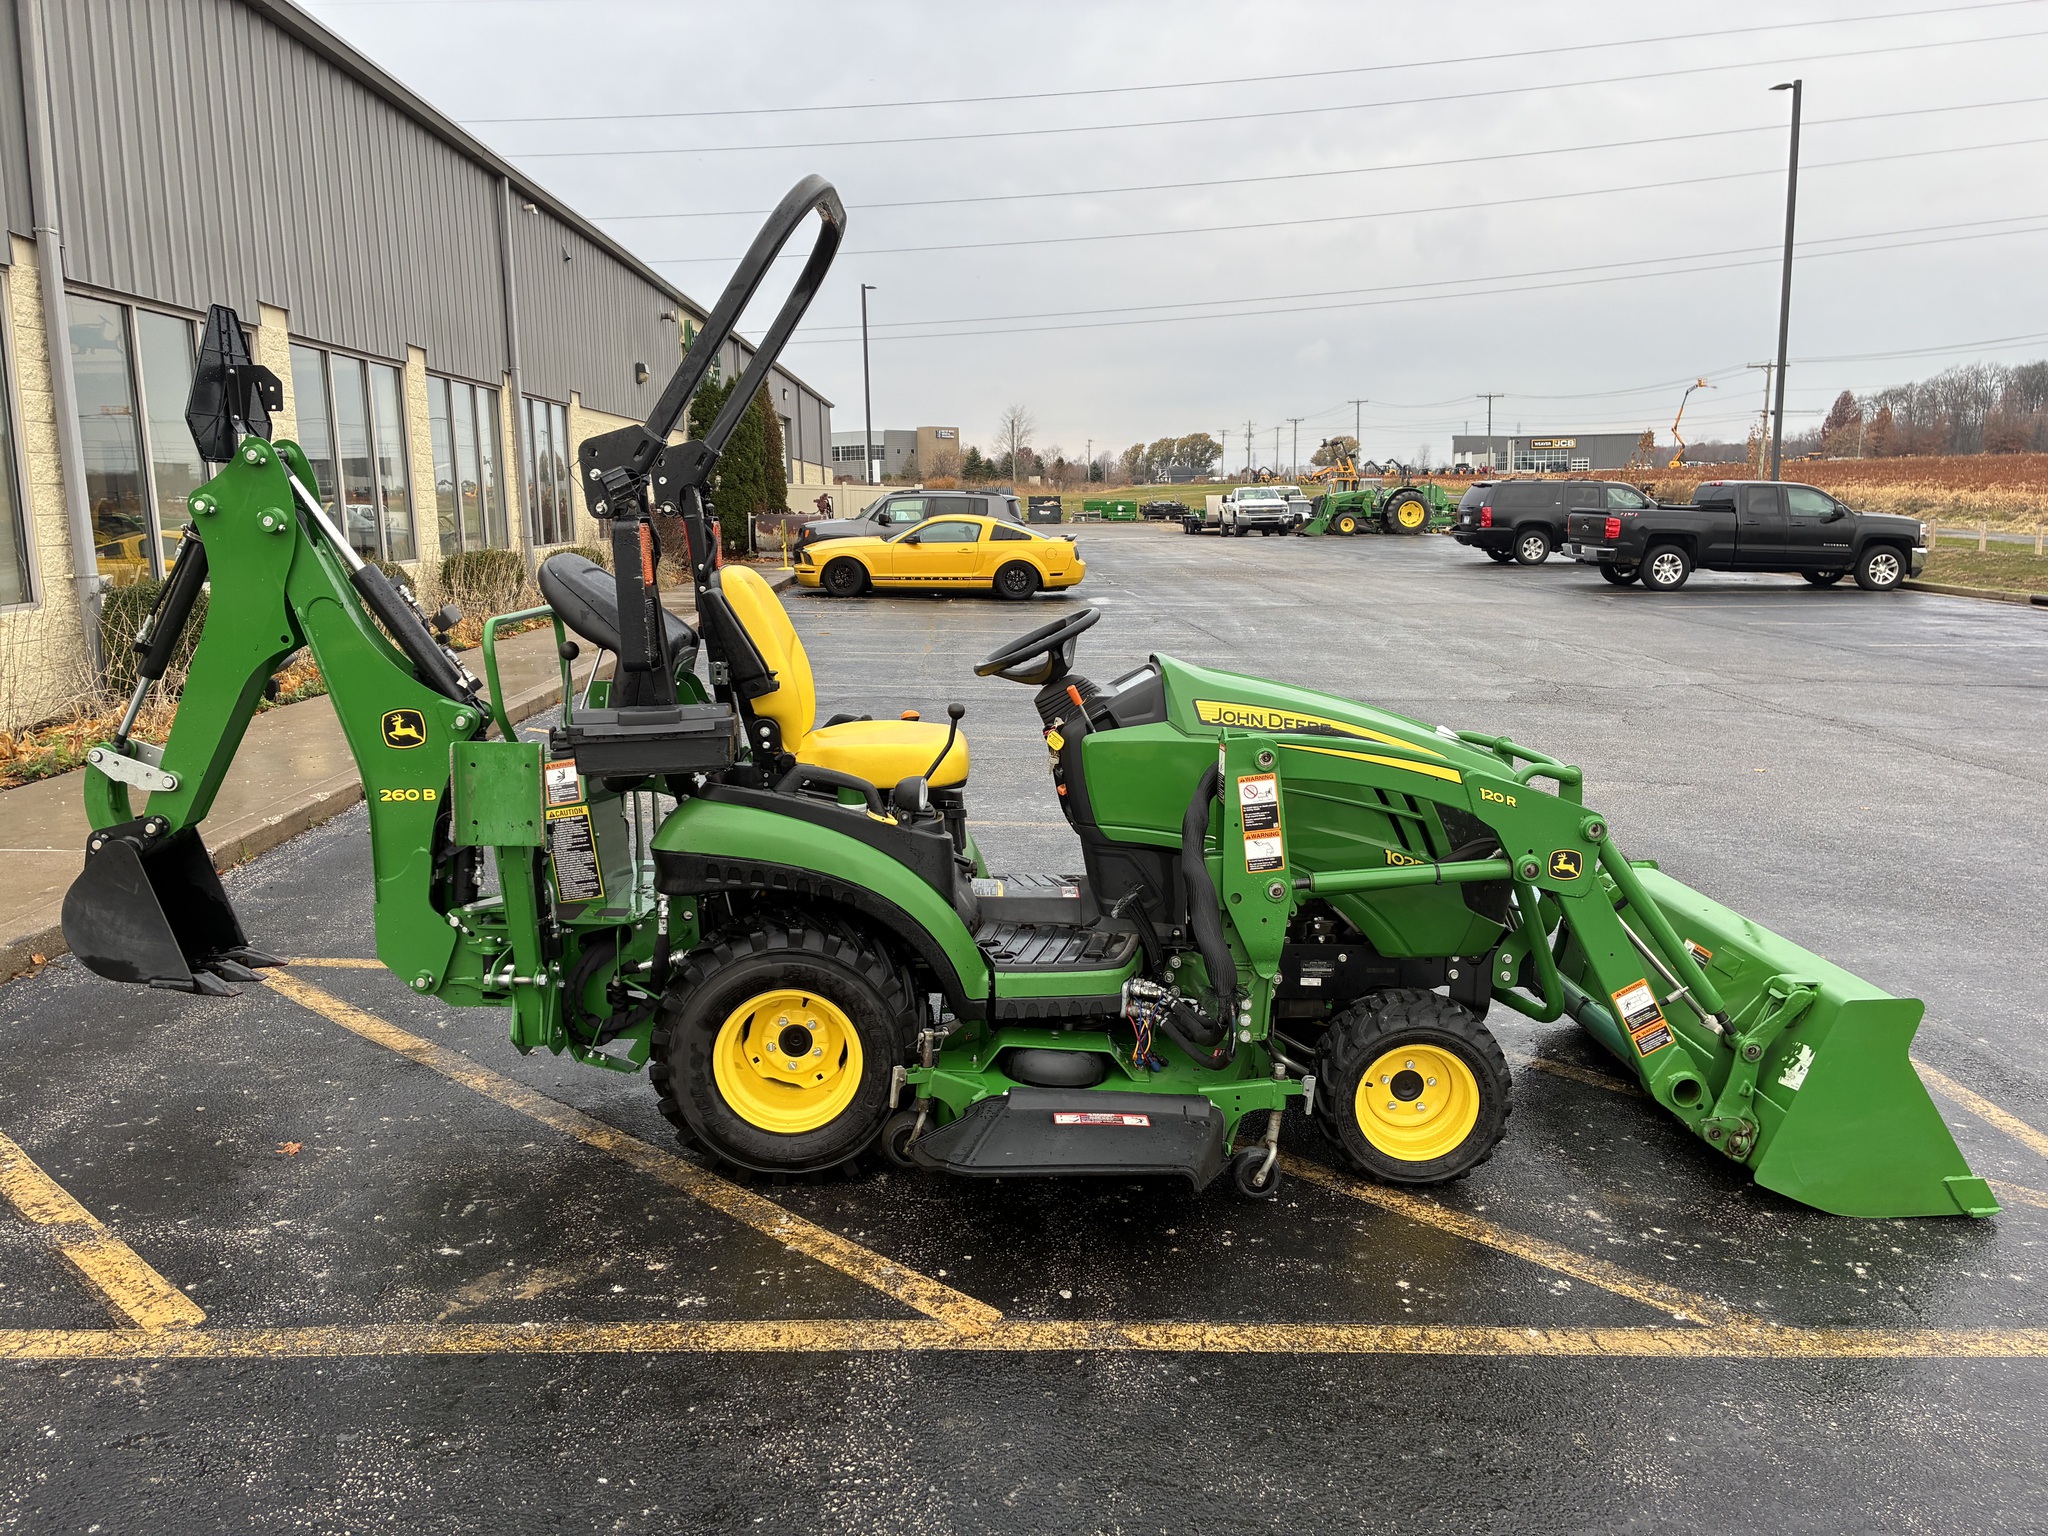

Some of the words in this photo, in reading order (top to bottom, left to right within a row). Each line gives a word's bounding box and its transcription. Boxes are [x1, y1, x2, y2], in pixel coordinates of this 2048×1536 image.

[1211, 707, 1263, 727] JOHN
[1268, 712, 1332, 729] DEE
[1244, 773, 1274, 783] WARNING
[379, 788, 420, 802] 260
[422, 788, 437, 802] B
[1479, 787, 1504, 803] 120
[1506, 794, 1517, 808] R
[555, 807, 583, 818] CAUTION
[1250, 832, 1280, 840] WARNING
